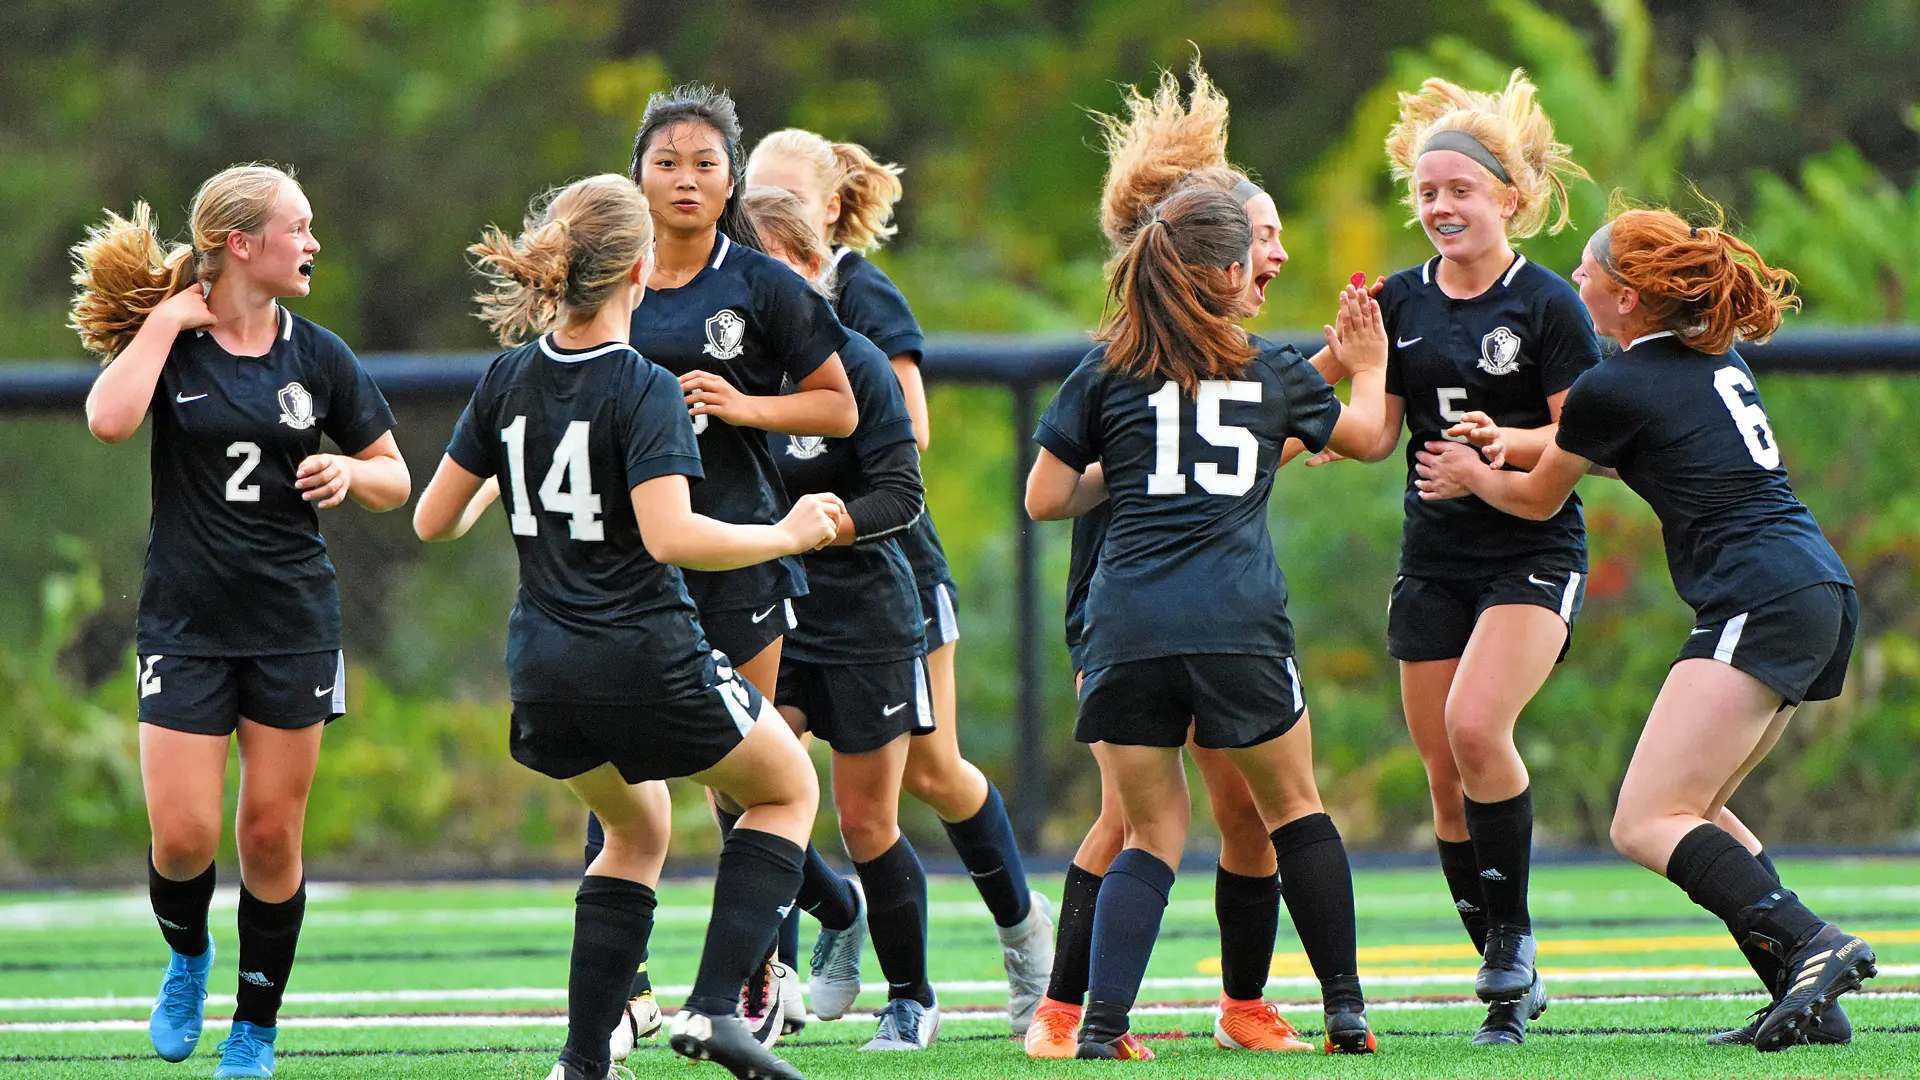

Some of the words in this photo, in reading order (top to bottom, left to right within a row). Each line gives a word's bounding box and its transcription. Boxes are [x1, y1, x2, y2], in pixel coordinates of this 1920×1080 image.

[1147, 379, 1262, 497] 15
[1436, 387, 1469, 444] 5
[1713, 366, 1780, 470] 6
[226, 441, 262, 502] 2
[501, 415, 604, 541] 14
